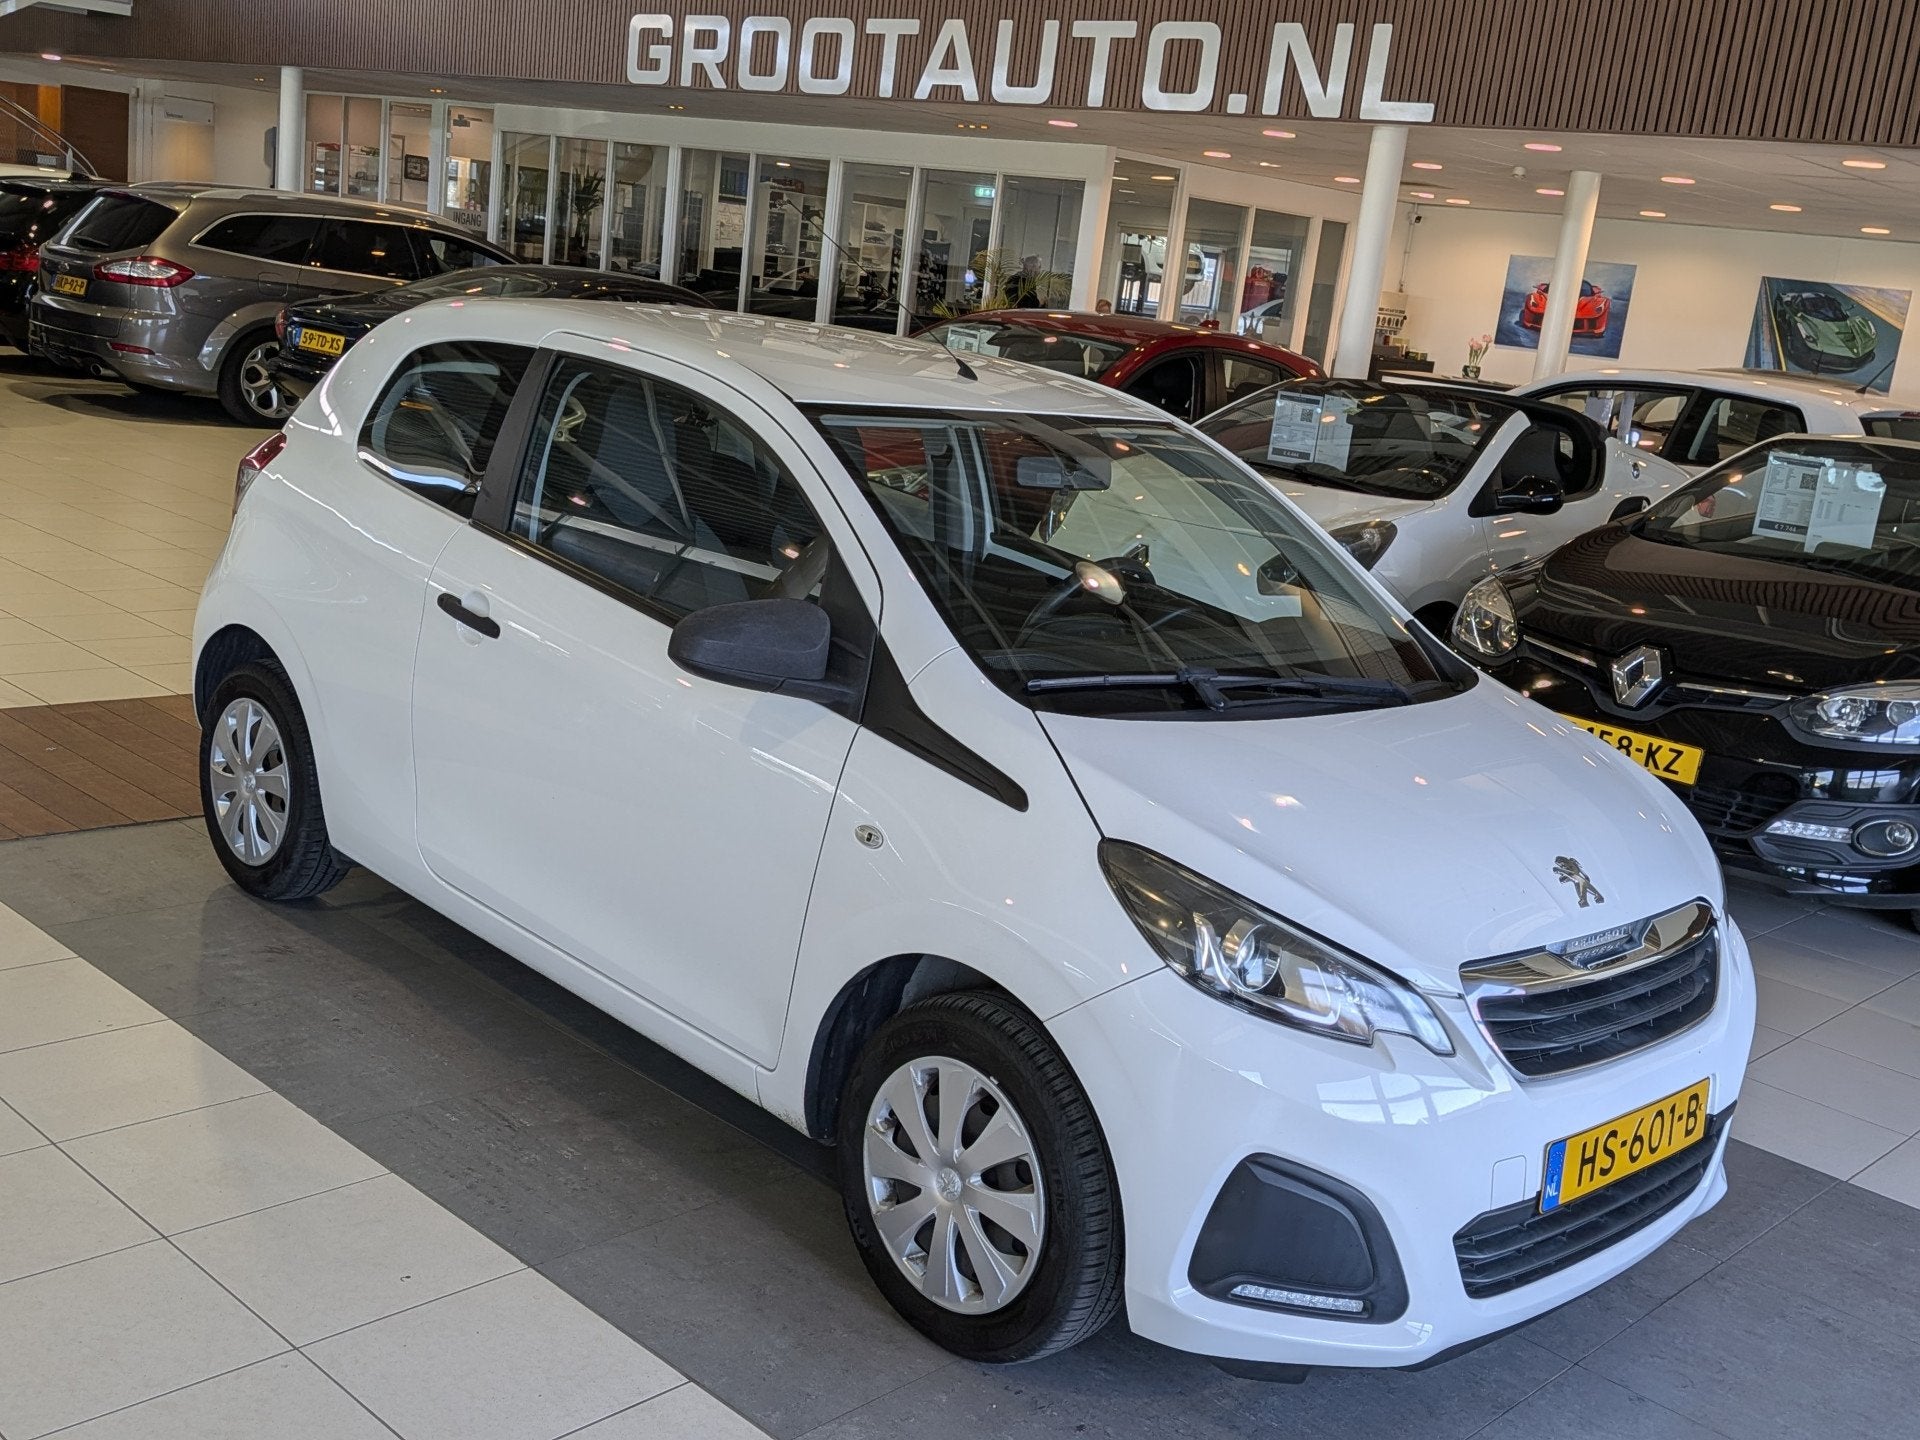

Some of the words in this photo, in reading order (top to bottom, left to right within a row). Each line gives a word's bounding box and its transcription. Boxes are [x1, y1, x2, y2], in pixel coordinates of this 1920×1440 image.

[627, 13, 1435, 123] GROOTAUTO.NL
[453, 211, 482, 227] INGANG
[302, 331, 341, 351] 59-TD-XS
[1586, 727, 1684, 776] 8-KZ
[1577, 1092, 1700, 1188] HS-601-B
[1545, 1184, 1559, 1199] NL
